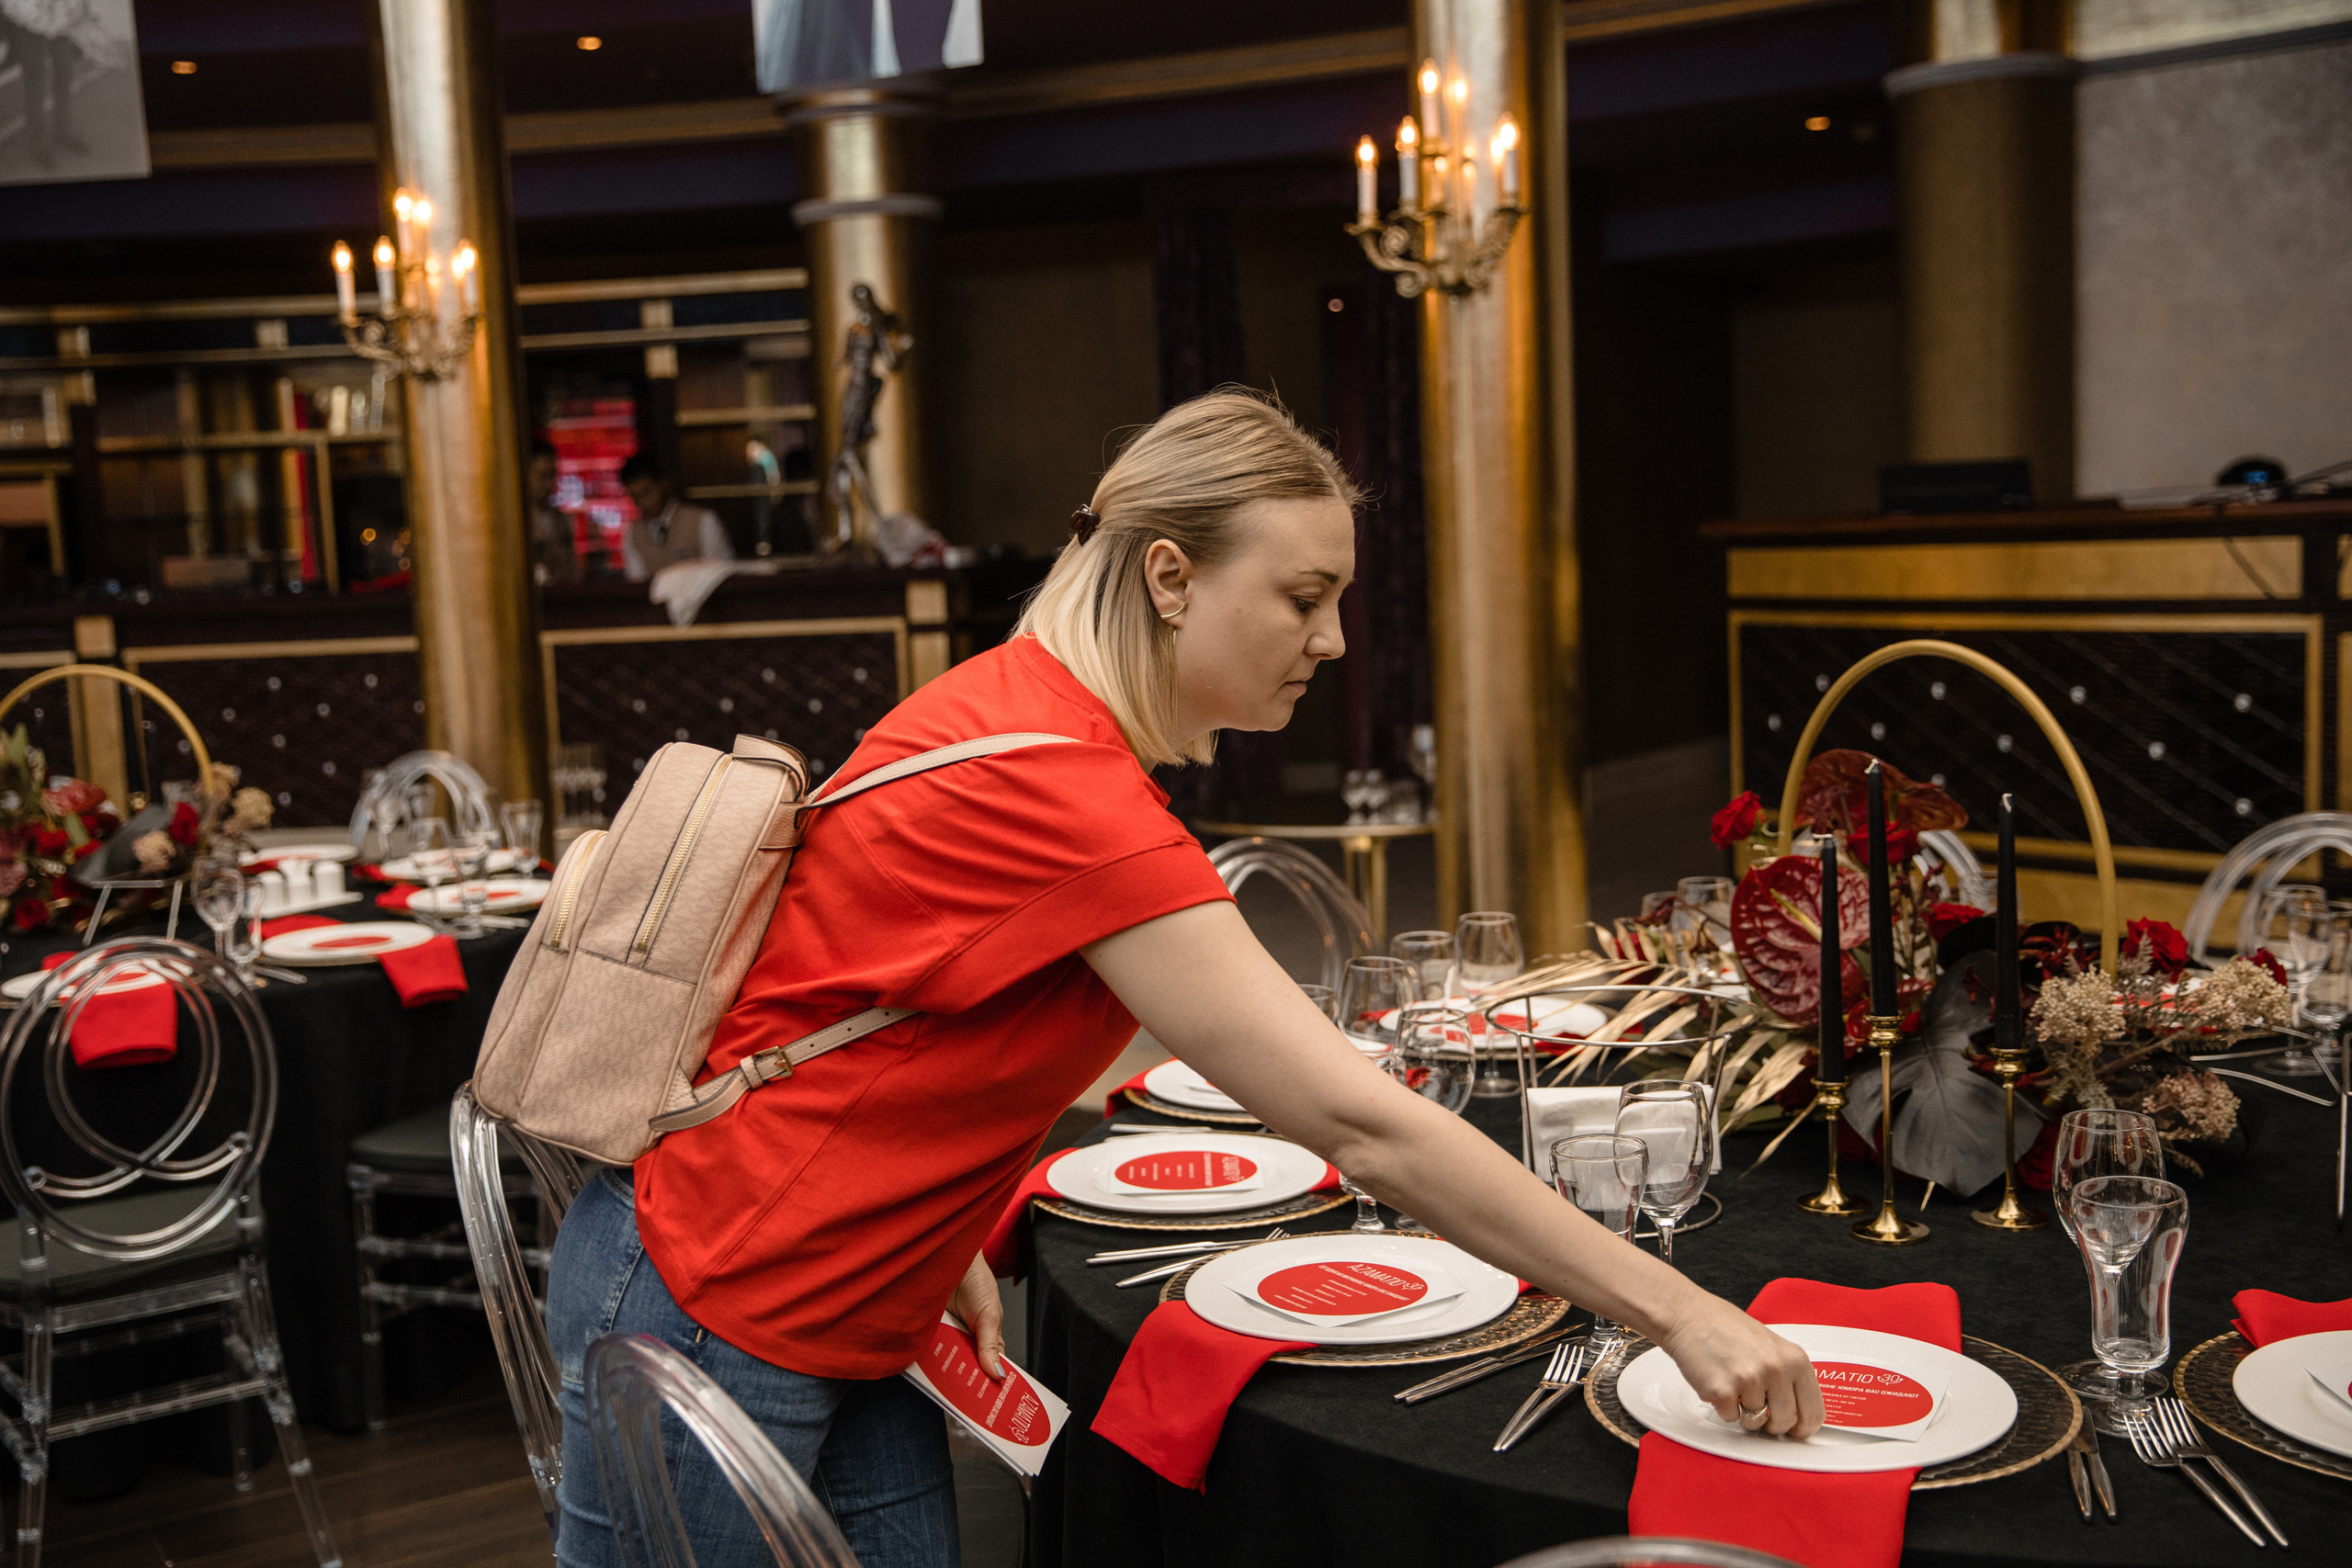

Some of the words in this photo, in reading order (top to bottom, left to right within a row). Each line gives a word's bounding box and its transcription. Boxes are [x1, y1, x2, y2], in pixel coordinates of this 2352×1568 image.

[1346, 1264, 1407, 1287] AZAMATIO
[1881, 1390, 1919, 1398] ОЖИДАЮТ
[1012, 1392, 1039, 1432] AZAMATIO
